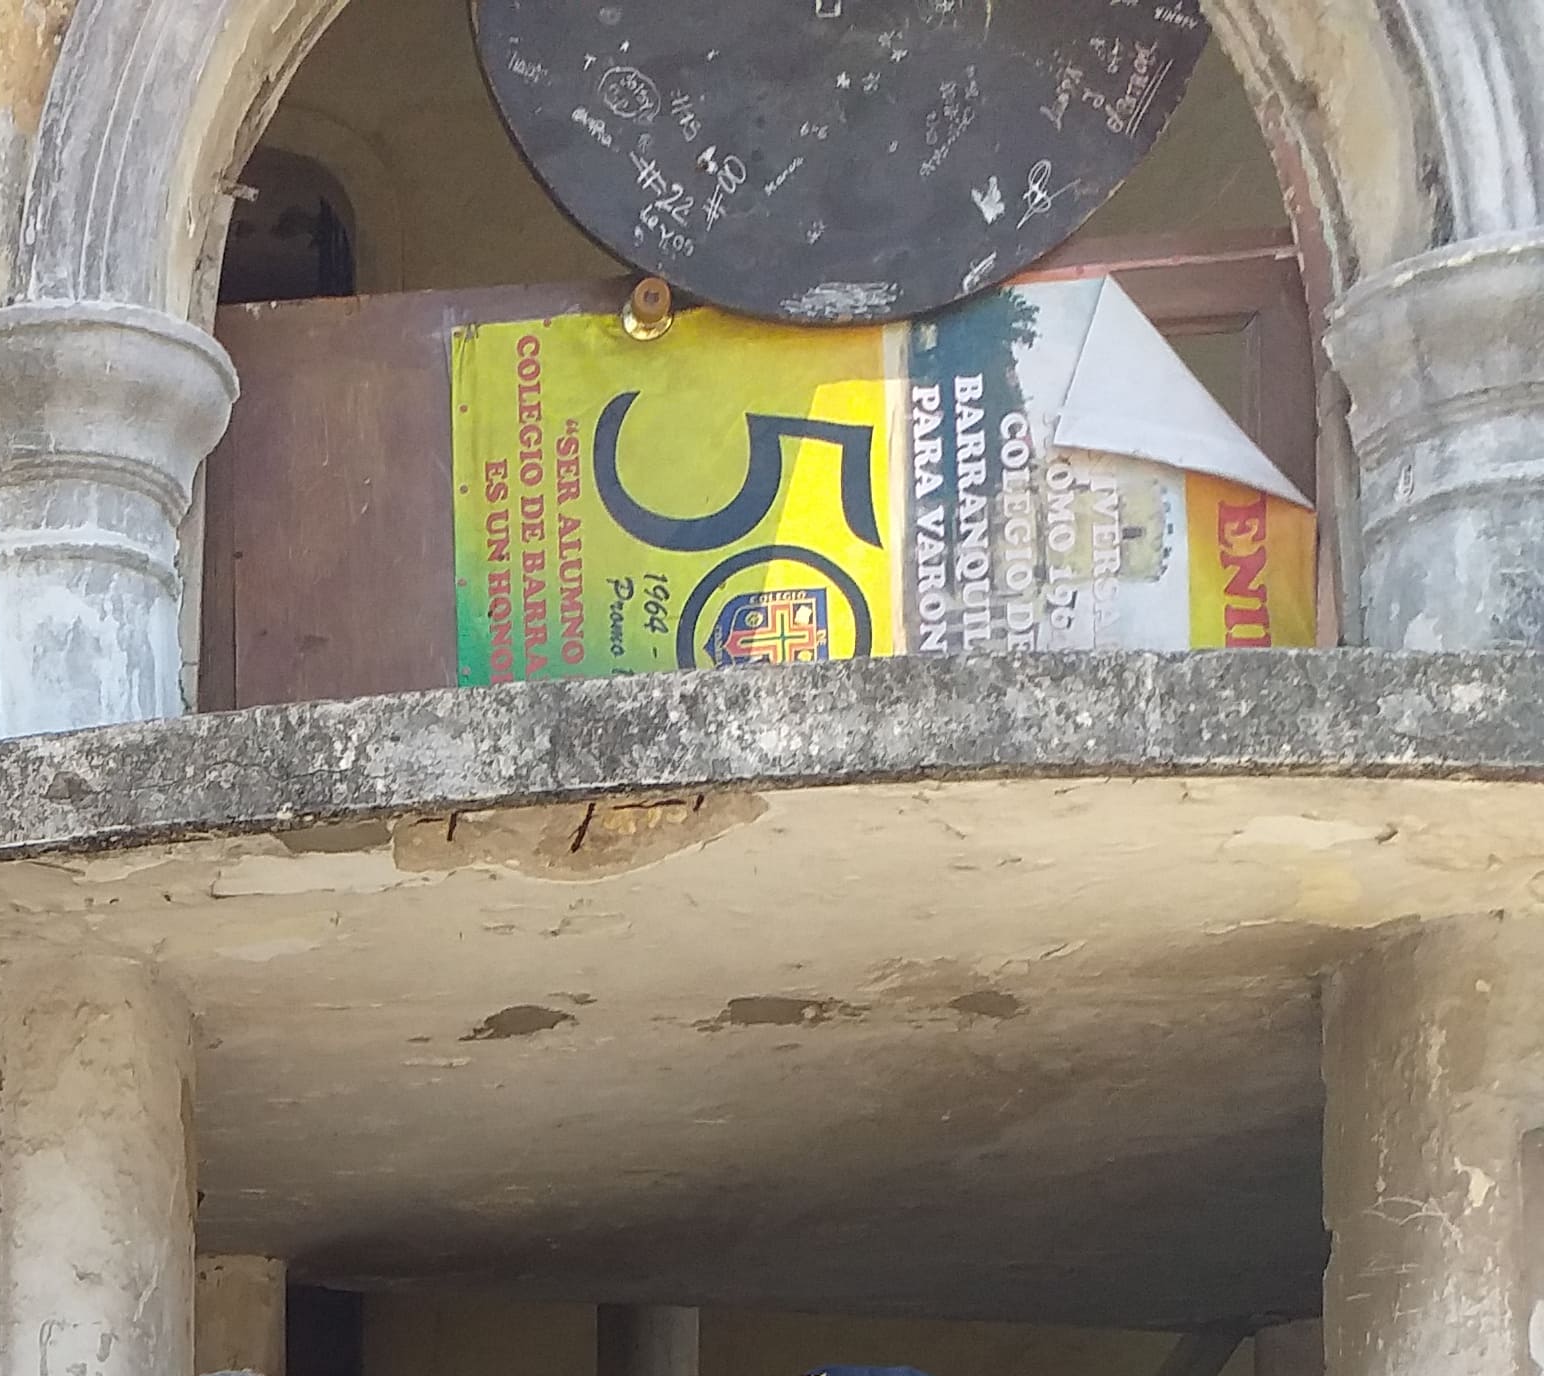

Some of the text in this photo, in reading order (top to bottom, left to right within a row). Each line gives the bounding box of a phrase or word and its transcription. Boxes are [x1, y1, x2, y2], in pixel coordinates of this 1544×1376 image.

[485, 458, 509, 501] ES
[516, 335, 549, 681] COLEGIO DE BARRA
[911, 384, 945, 499] PARA
[486, 509, 512, 562] UN
[557, 513, 585, 664] ALUMNO
[643, 573, 671, 634] 1964
[999, 411, 1036, 651] COLEGIO DE
[1045, 452, 1078, 643] OMO 196
[1090, 475, 1122, 648] IVERSA
[1217, 490, 1272, 648] ENI
[607, 576, 634, 658] Promo
